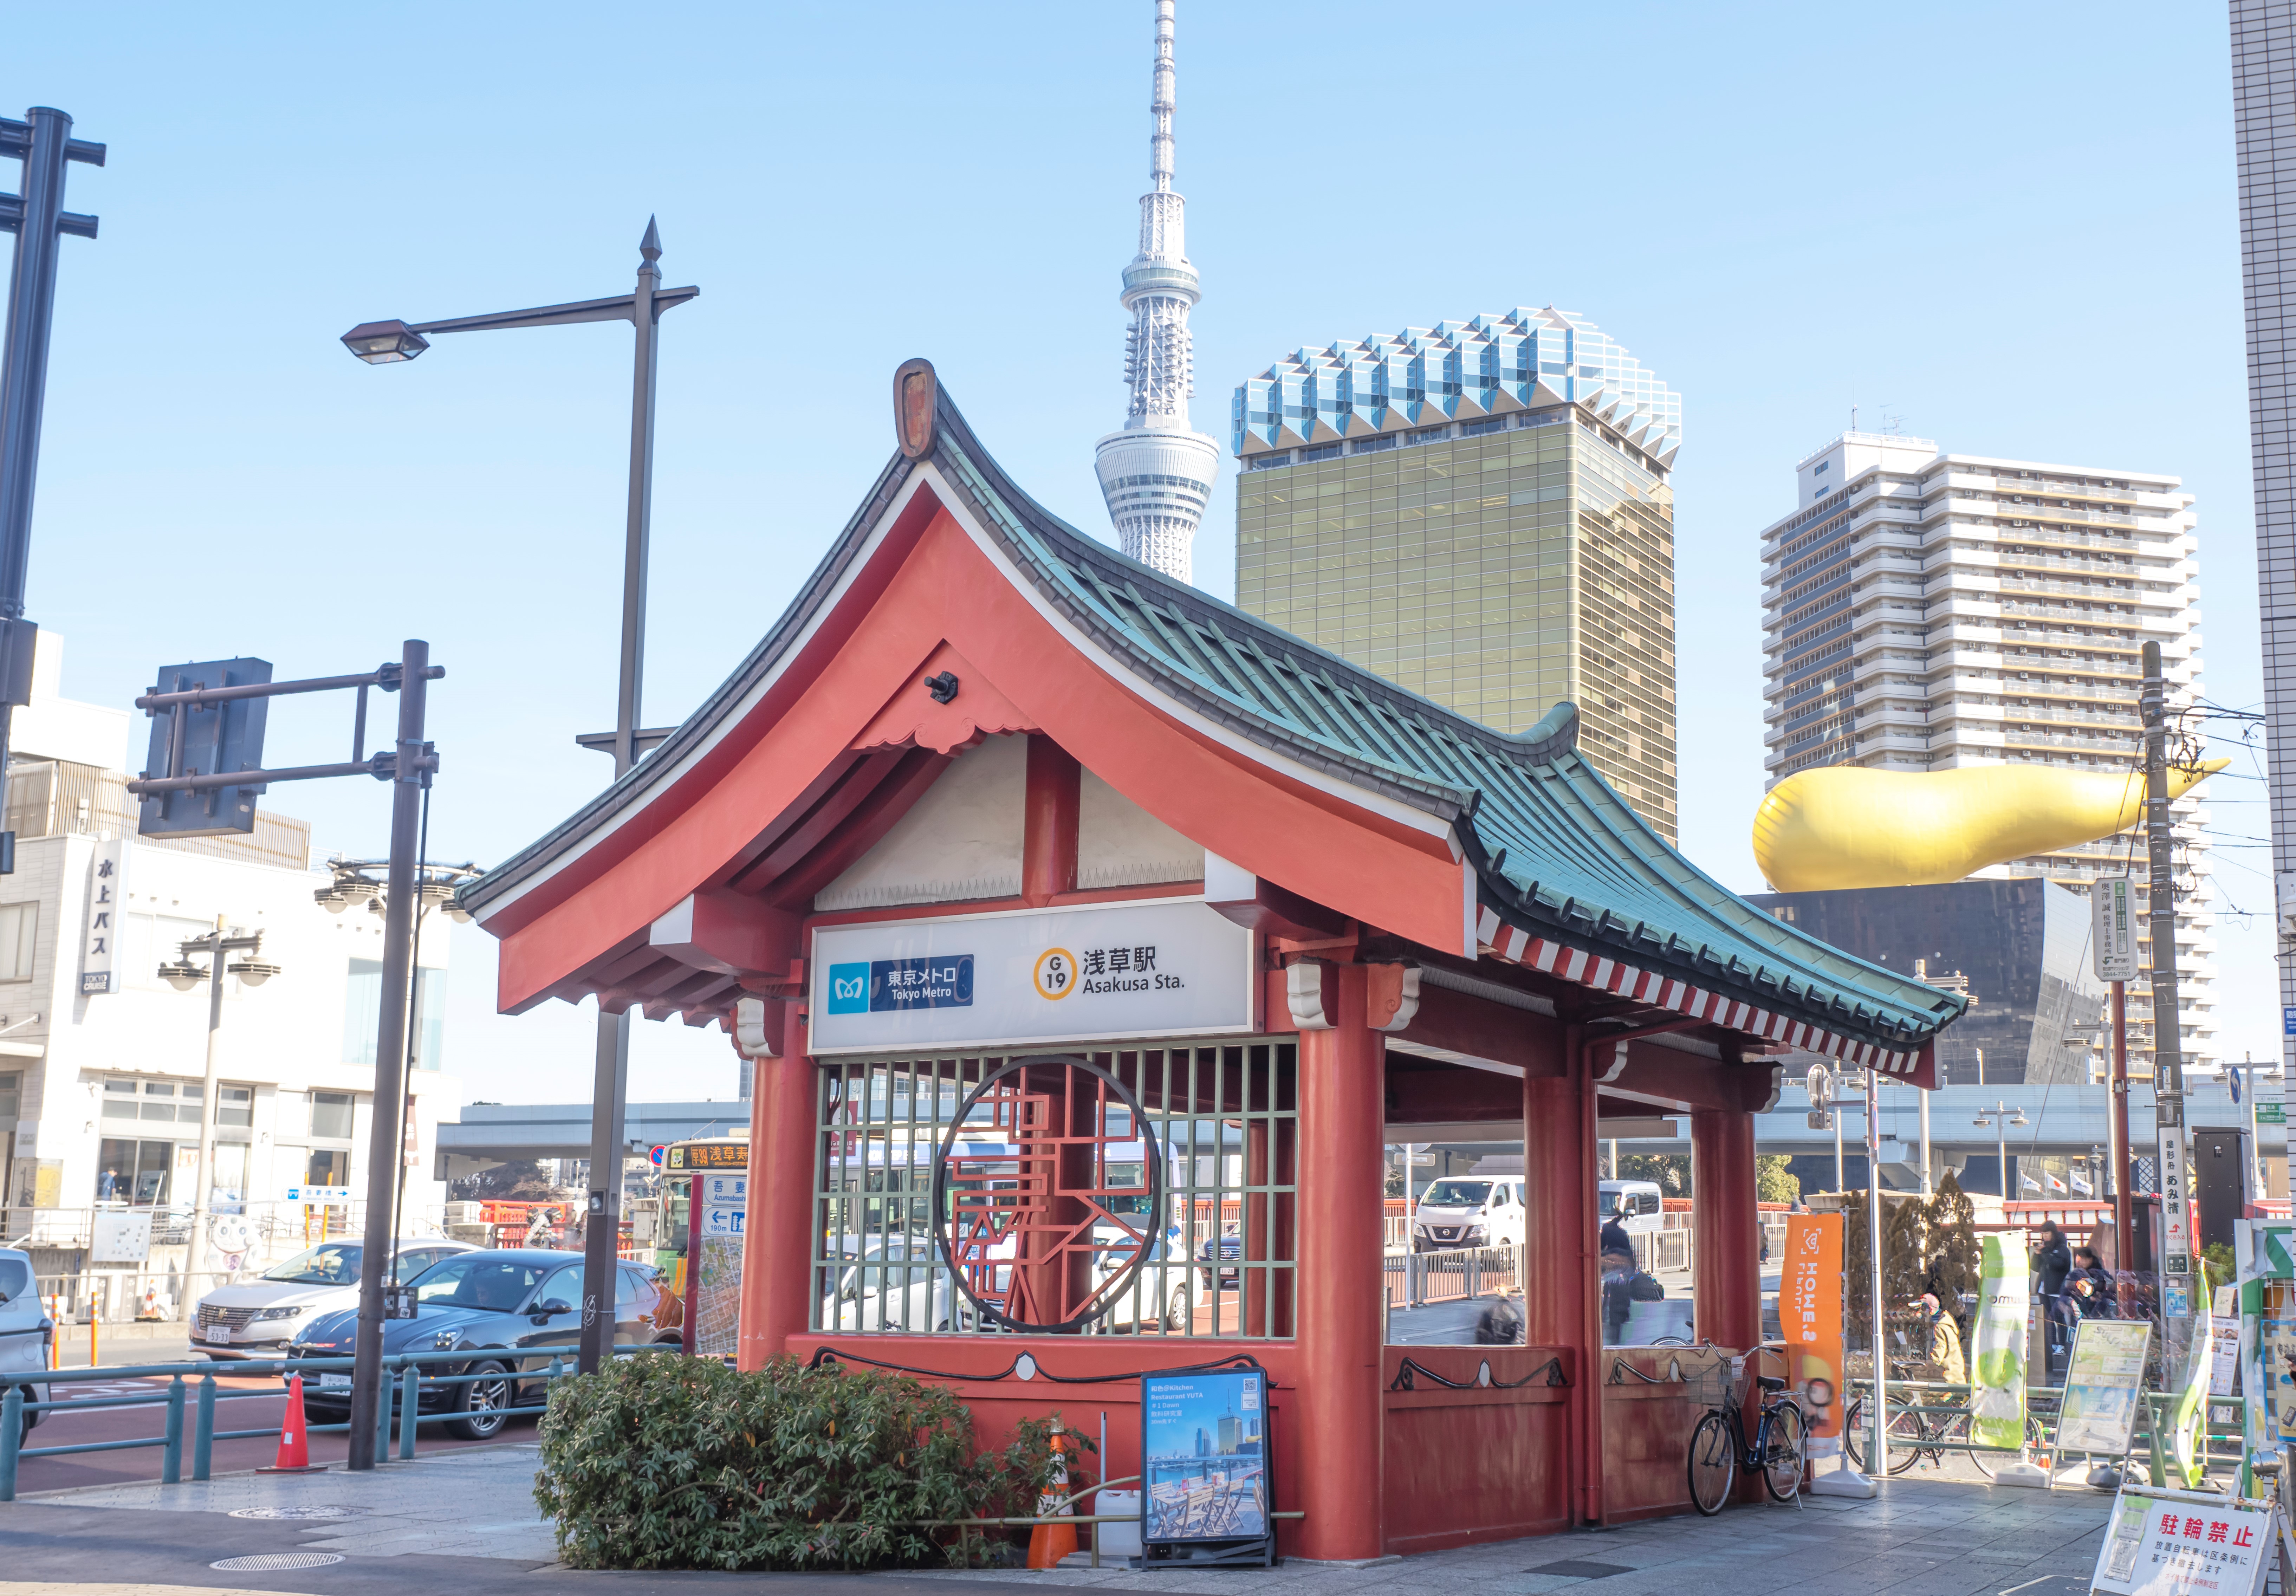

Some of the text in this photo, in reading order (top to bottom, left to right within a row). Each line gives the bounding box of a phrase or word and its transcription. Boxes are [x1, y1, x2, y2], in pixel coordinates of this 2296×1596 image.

[91, 859, 113, 955] 水上バス
[1050, 956, 1061, 971] G
[1083, 946, 1155, 975] 浅草駅
[85, 974, 107, 983] TOKYO
[888, 967, 956, 987] 東京メトロ
[1047, 973, 1065, 988] 19
[1083, 974, 1185, 994] Asakusa Sta.
[892, 987, 951, 1001] Tokyo Metro
[2158, 1514, 2253, 1548] 駐輪禁止
[2154, 1540, 2248, 1565] 放置自転車は区条例に
[2151, 1553, 2221, 1575] 基づき撤去します
